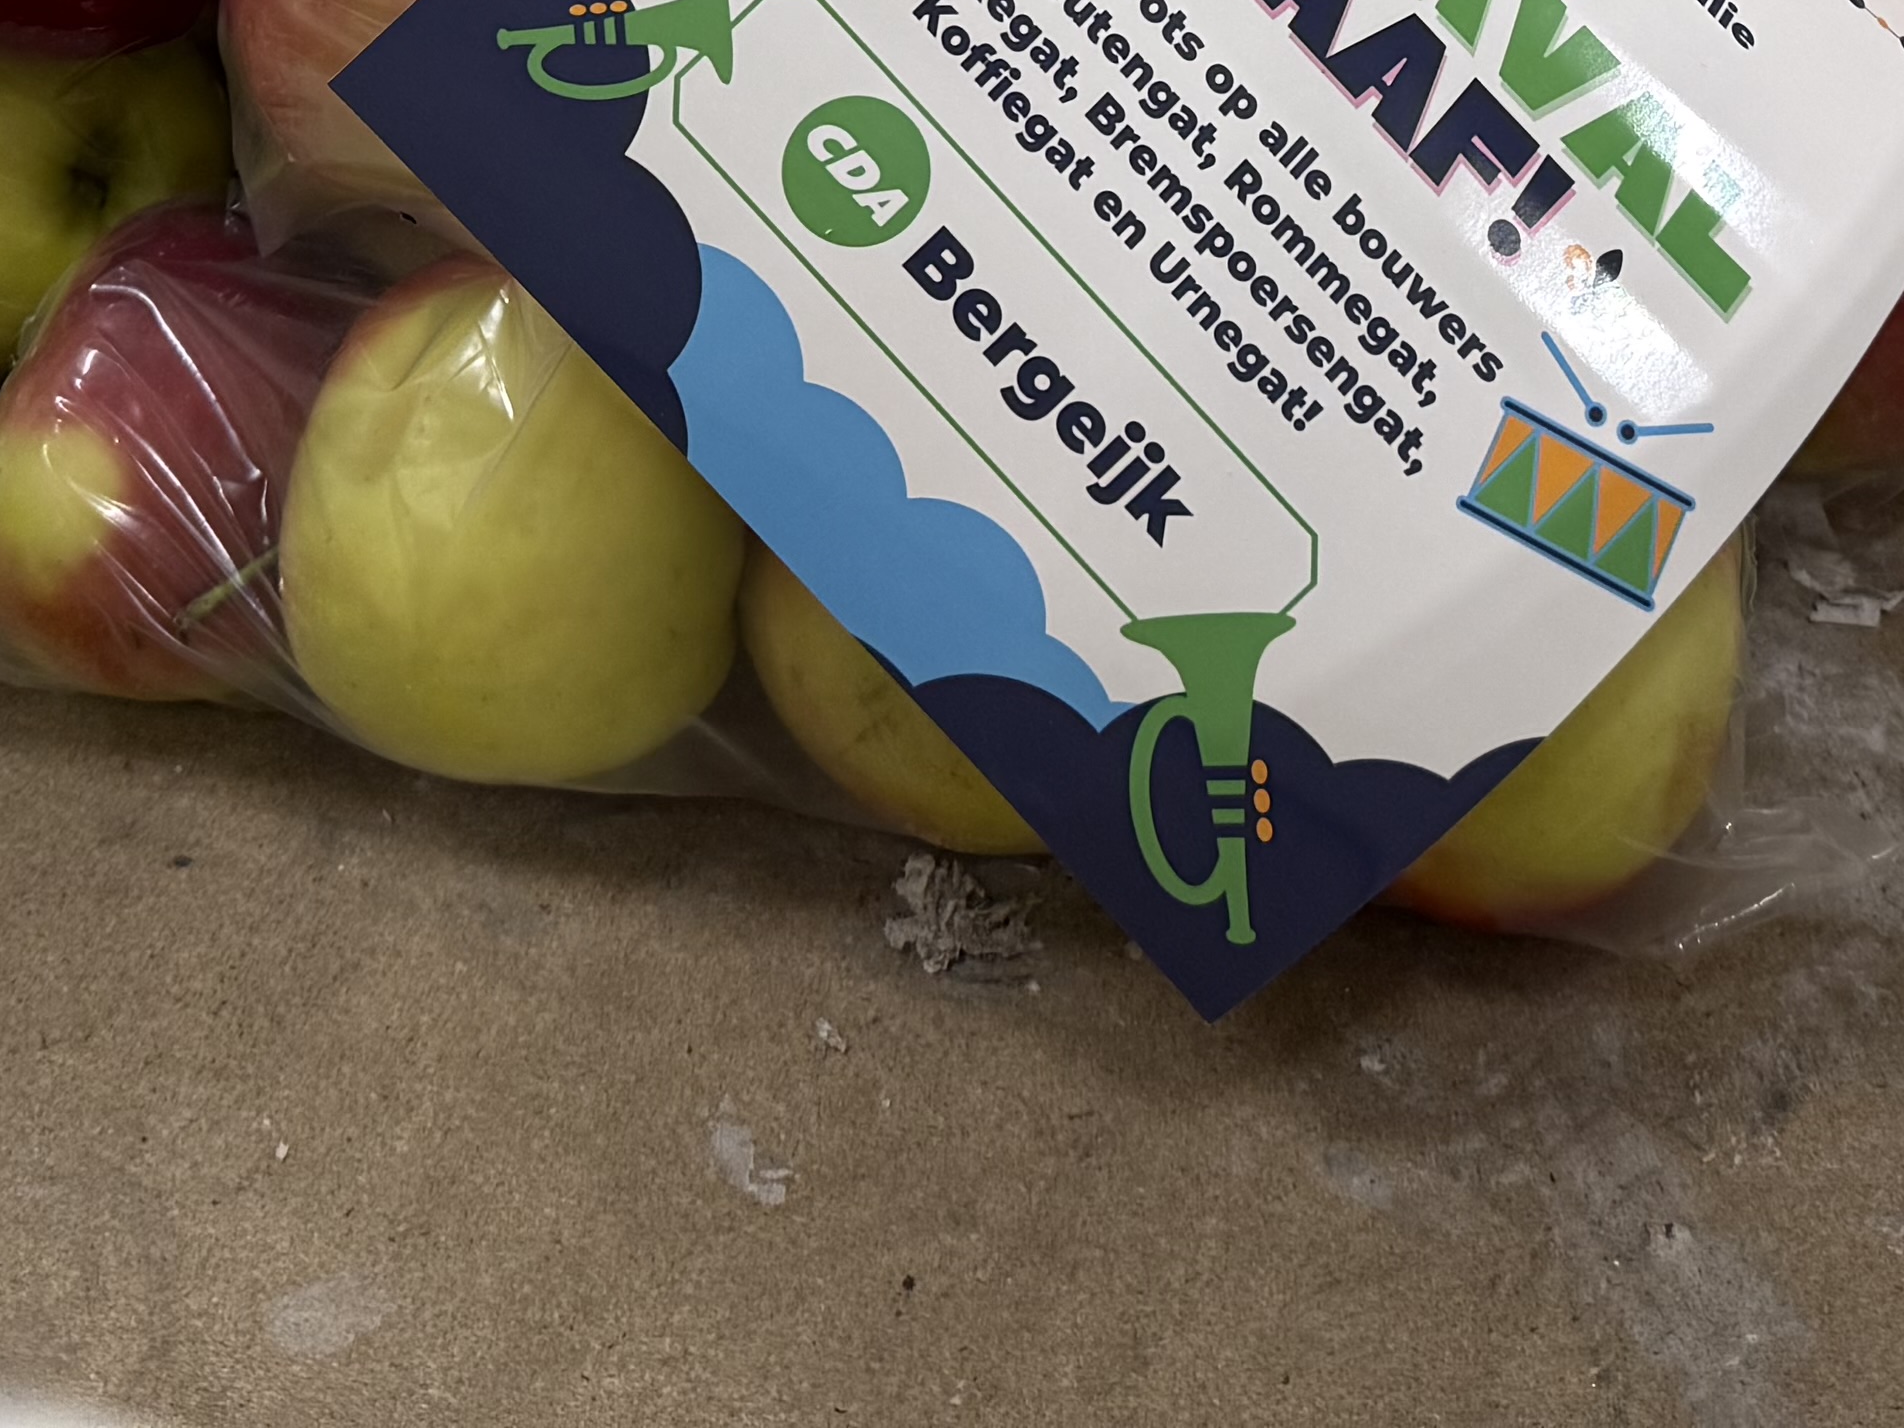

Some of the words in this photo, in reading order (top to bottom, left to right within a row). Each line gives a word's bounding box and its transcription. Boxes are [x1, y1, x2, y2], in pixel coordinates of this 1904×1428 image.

[806, 123, 910, 228] CDA
[1084, 91, 1424, 477] Bremspoersengat,
[1093, 190, 1147, 250] en
[1149, 240, 1324, 432] Urnegat!
[1204, 63, 1258, 120] op
[1258, 120, 1333, 201] alle
[1332, 193, 1504, 383] bouwers
[1223, 158, 1437, 408] Rommegat,
[901, 225, 1194, 549] Bergeijk
